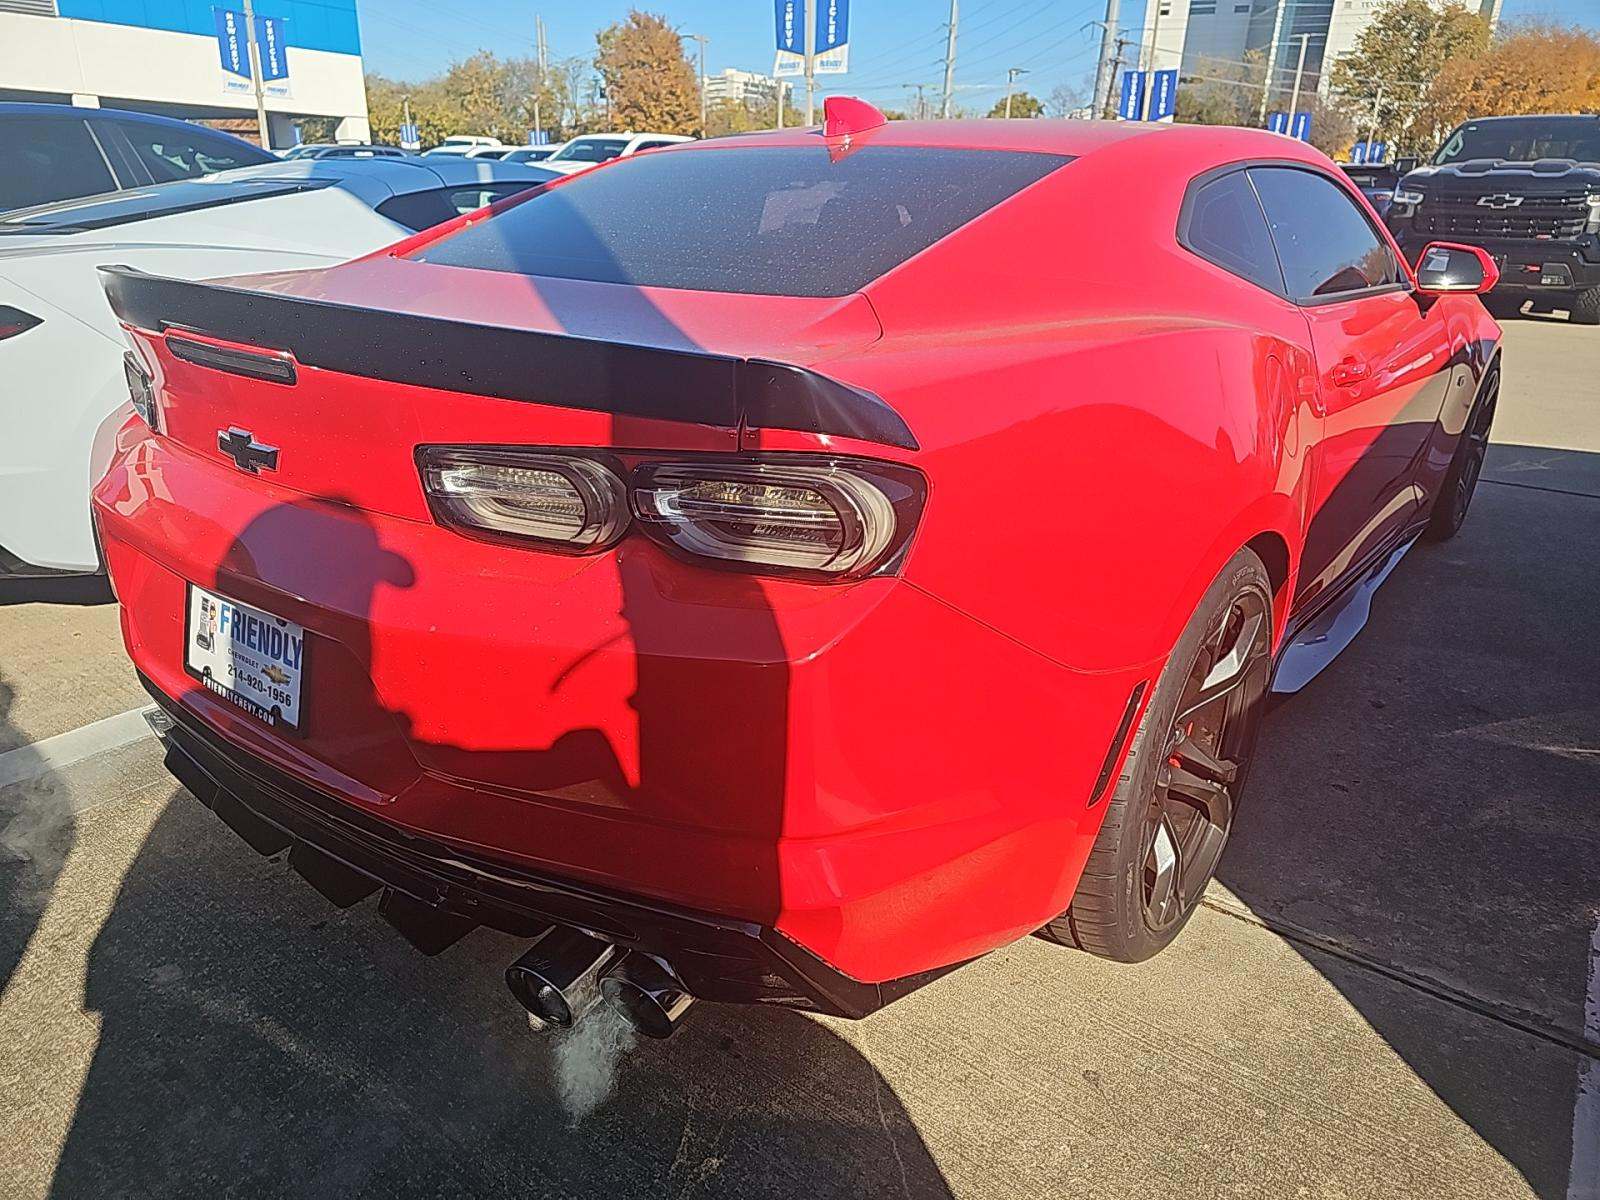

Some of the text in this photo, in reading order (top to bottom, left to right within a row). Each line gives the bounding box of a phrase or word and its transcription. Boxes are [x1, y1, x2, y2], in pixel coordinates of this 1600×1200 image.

[265, 20, 278, 75] VEHICLES
[1159, 74, 1169, 115] PARKING
[219, 602, 303, 670] FRIENDLY
[228, 648, 259, 669] CHEVROLET
[202, 676, 275, 726] FRIENDLYCHEVY.COM
[227, 663, 292, 708] 214-920-1956
